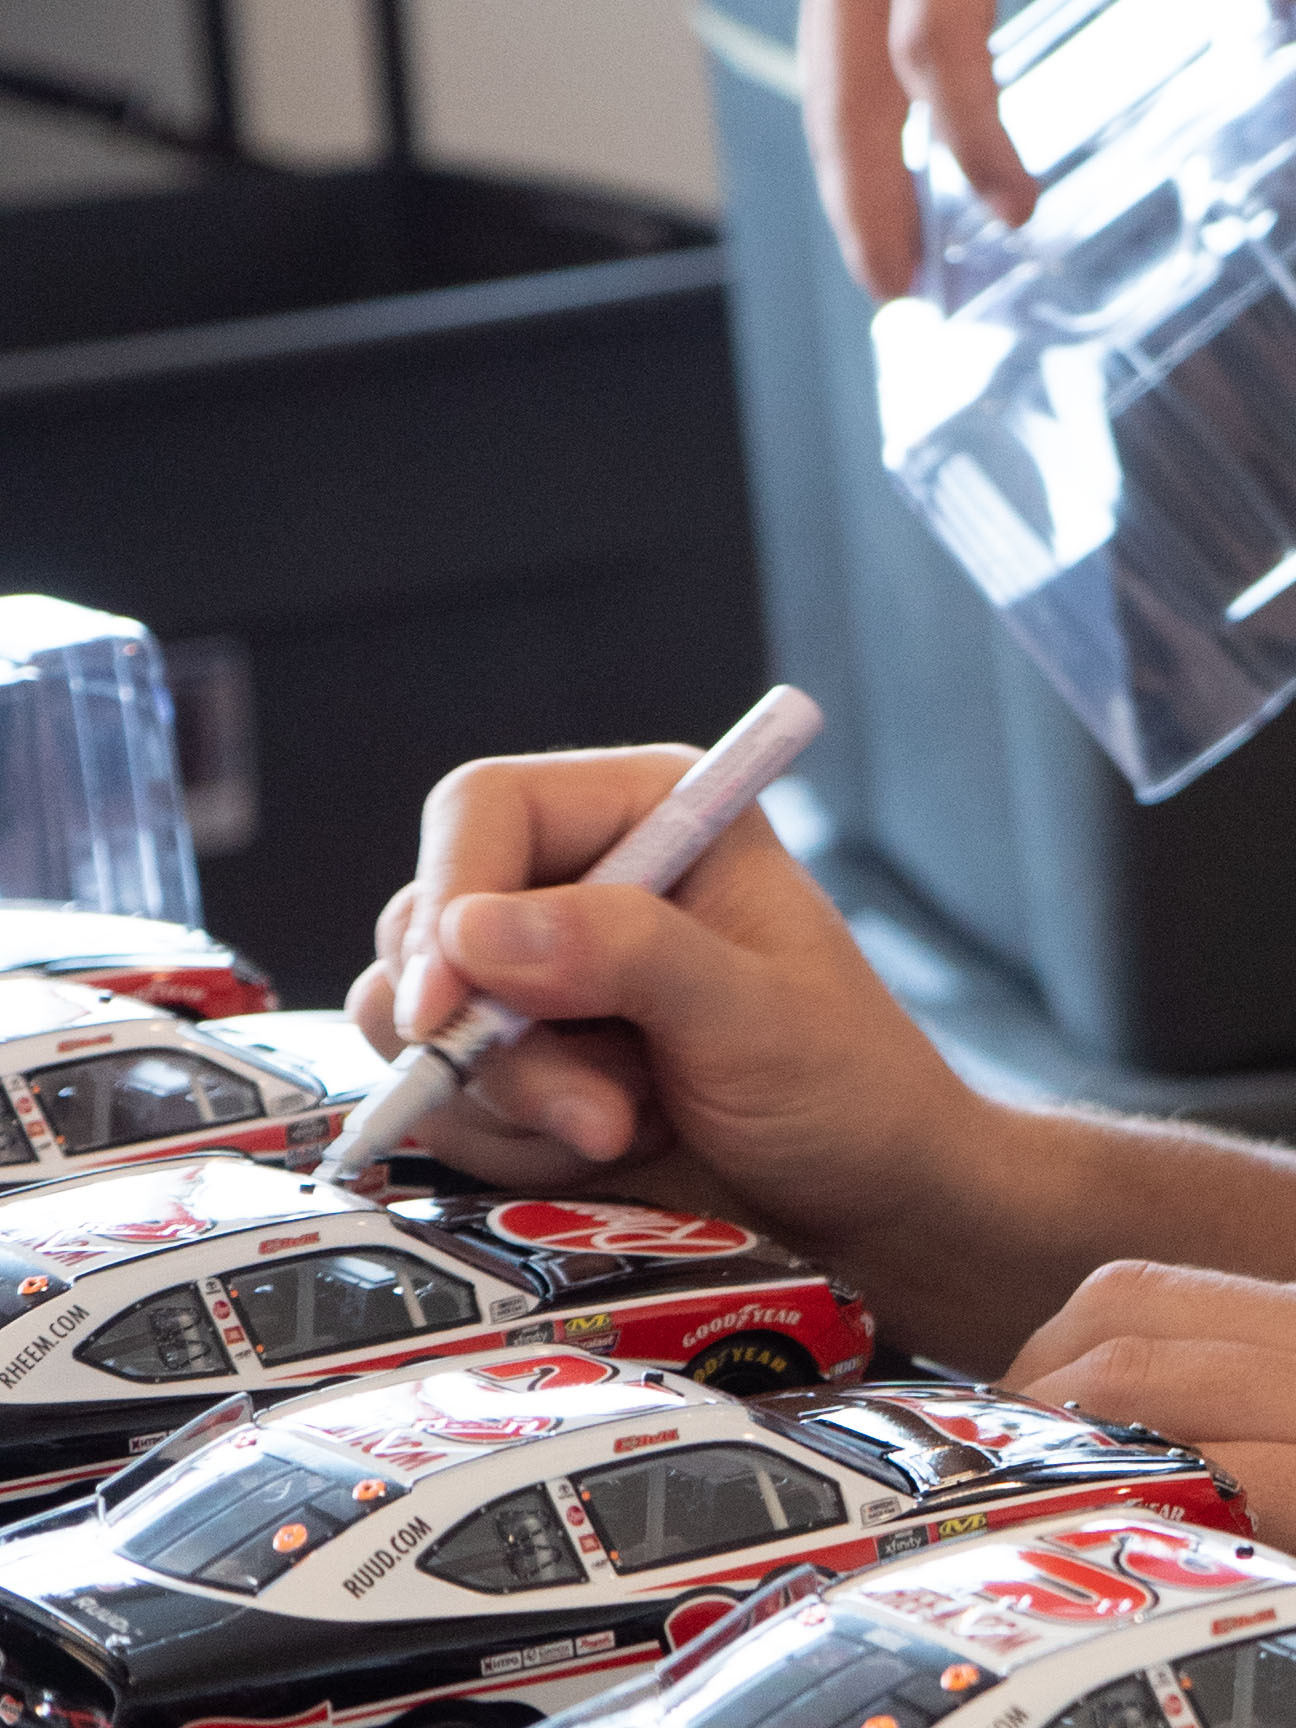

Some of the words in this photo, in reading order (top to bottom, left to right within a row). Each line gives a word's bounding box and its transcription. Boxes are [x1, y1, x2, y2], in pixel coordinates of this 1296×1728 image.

[0, 1303, 90, 1390] RHEEM.COM
[682, 1303, 804, 1349] GOODYEAR
[342, 1516, 434, 1600] RUUD.COM
[884, 1533, 922, 1558] xfinity
